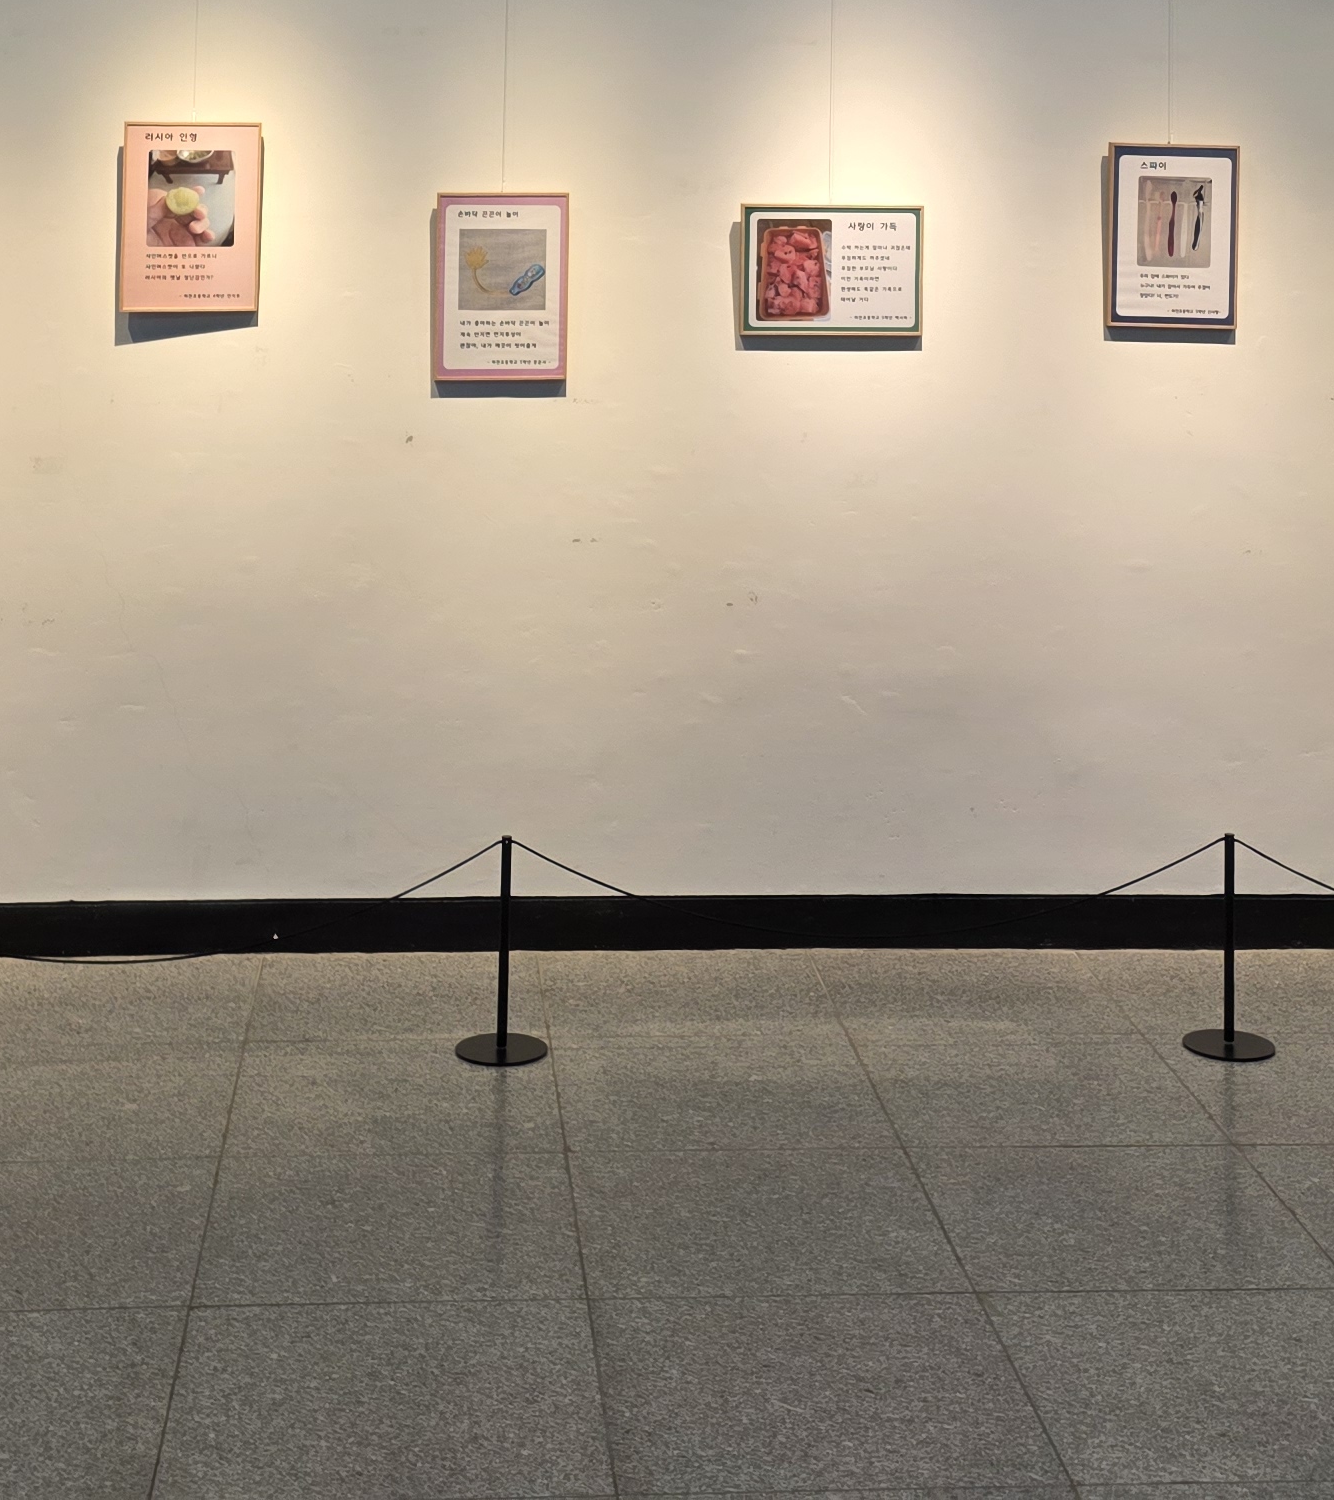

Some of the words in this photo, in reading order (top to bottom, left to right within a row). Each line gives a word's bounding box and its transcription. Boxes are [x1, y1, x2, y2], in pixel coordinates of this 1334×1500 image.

[145, 132, 173, 142] 러시아
[179, 132, 197, 143] 인형
[1140, 161, 1167, 171] 스파이
[848, 221, 874, 232] 사랑이
